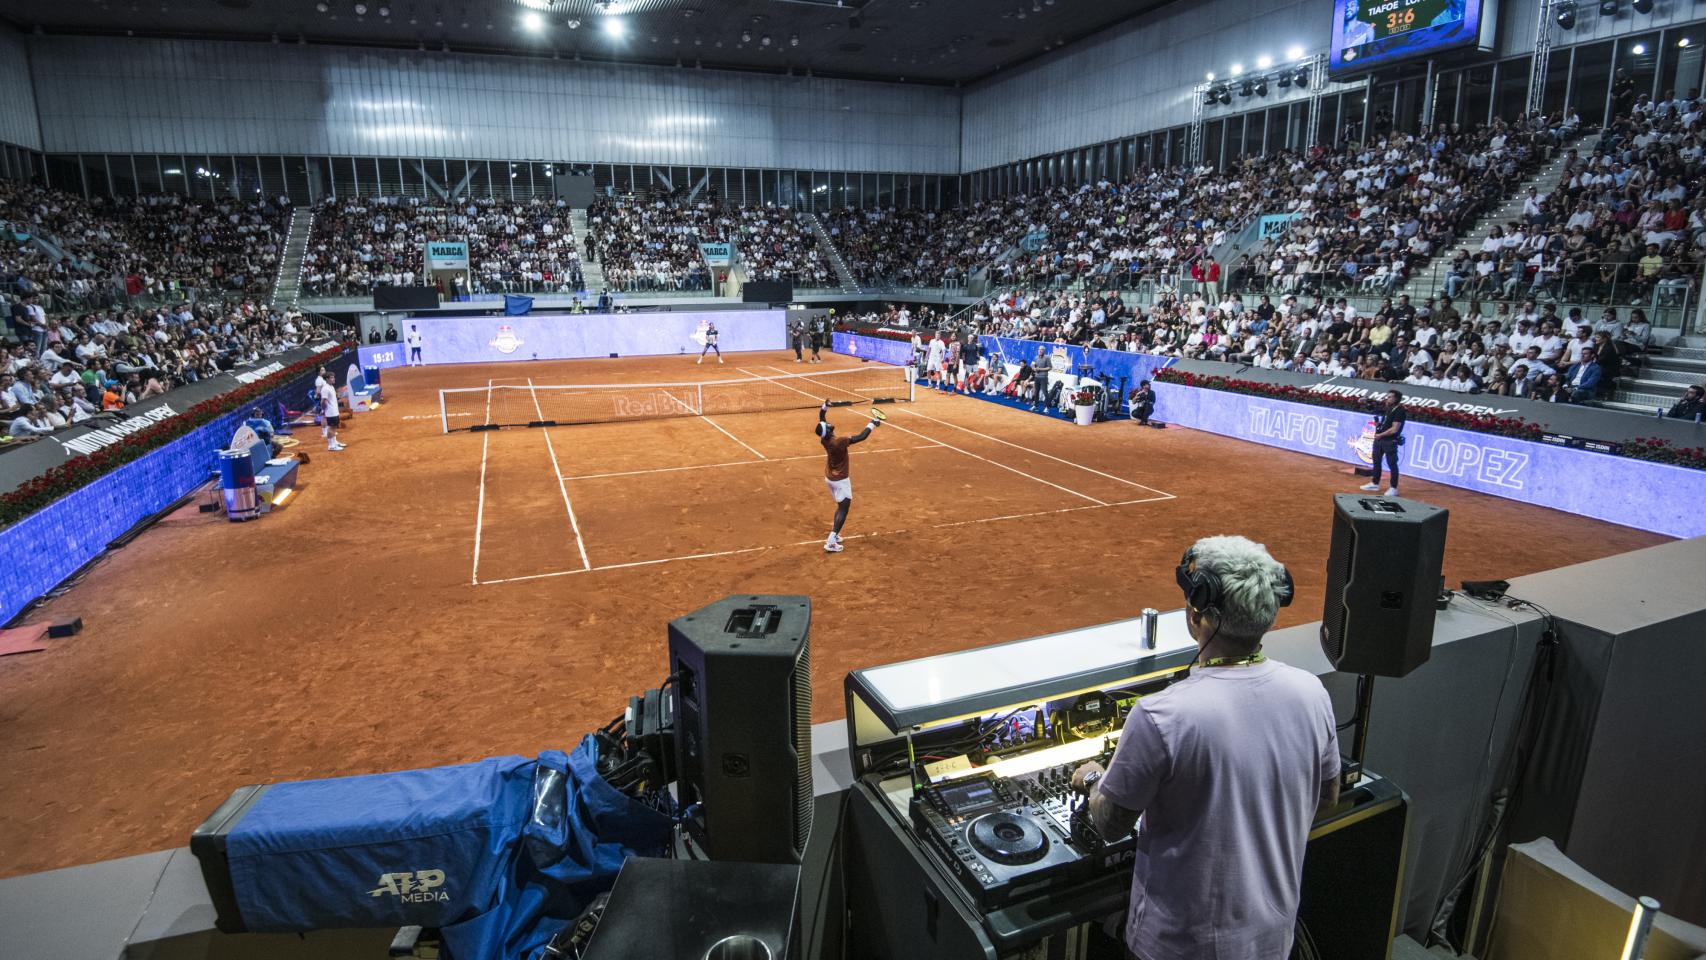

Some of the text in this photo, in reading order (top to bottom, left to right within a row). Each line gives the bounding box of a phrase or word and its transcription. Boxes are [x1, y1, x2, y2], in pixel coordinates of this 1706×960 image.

[1368, 2, 1399, 16] TIAFOE
[1386, 8, 1415, 28] 3:6
[432, 247, 463, 256] MARCA
[373, 351, 394, 363] 15:21
[1249, 405, 1339, 449] TIAFOE
[1410, 434, 1529, 490] LOPEZ
[366, 869, 446, 897] ATP
[401, 891, 450, 904] MEDIA
